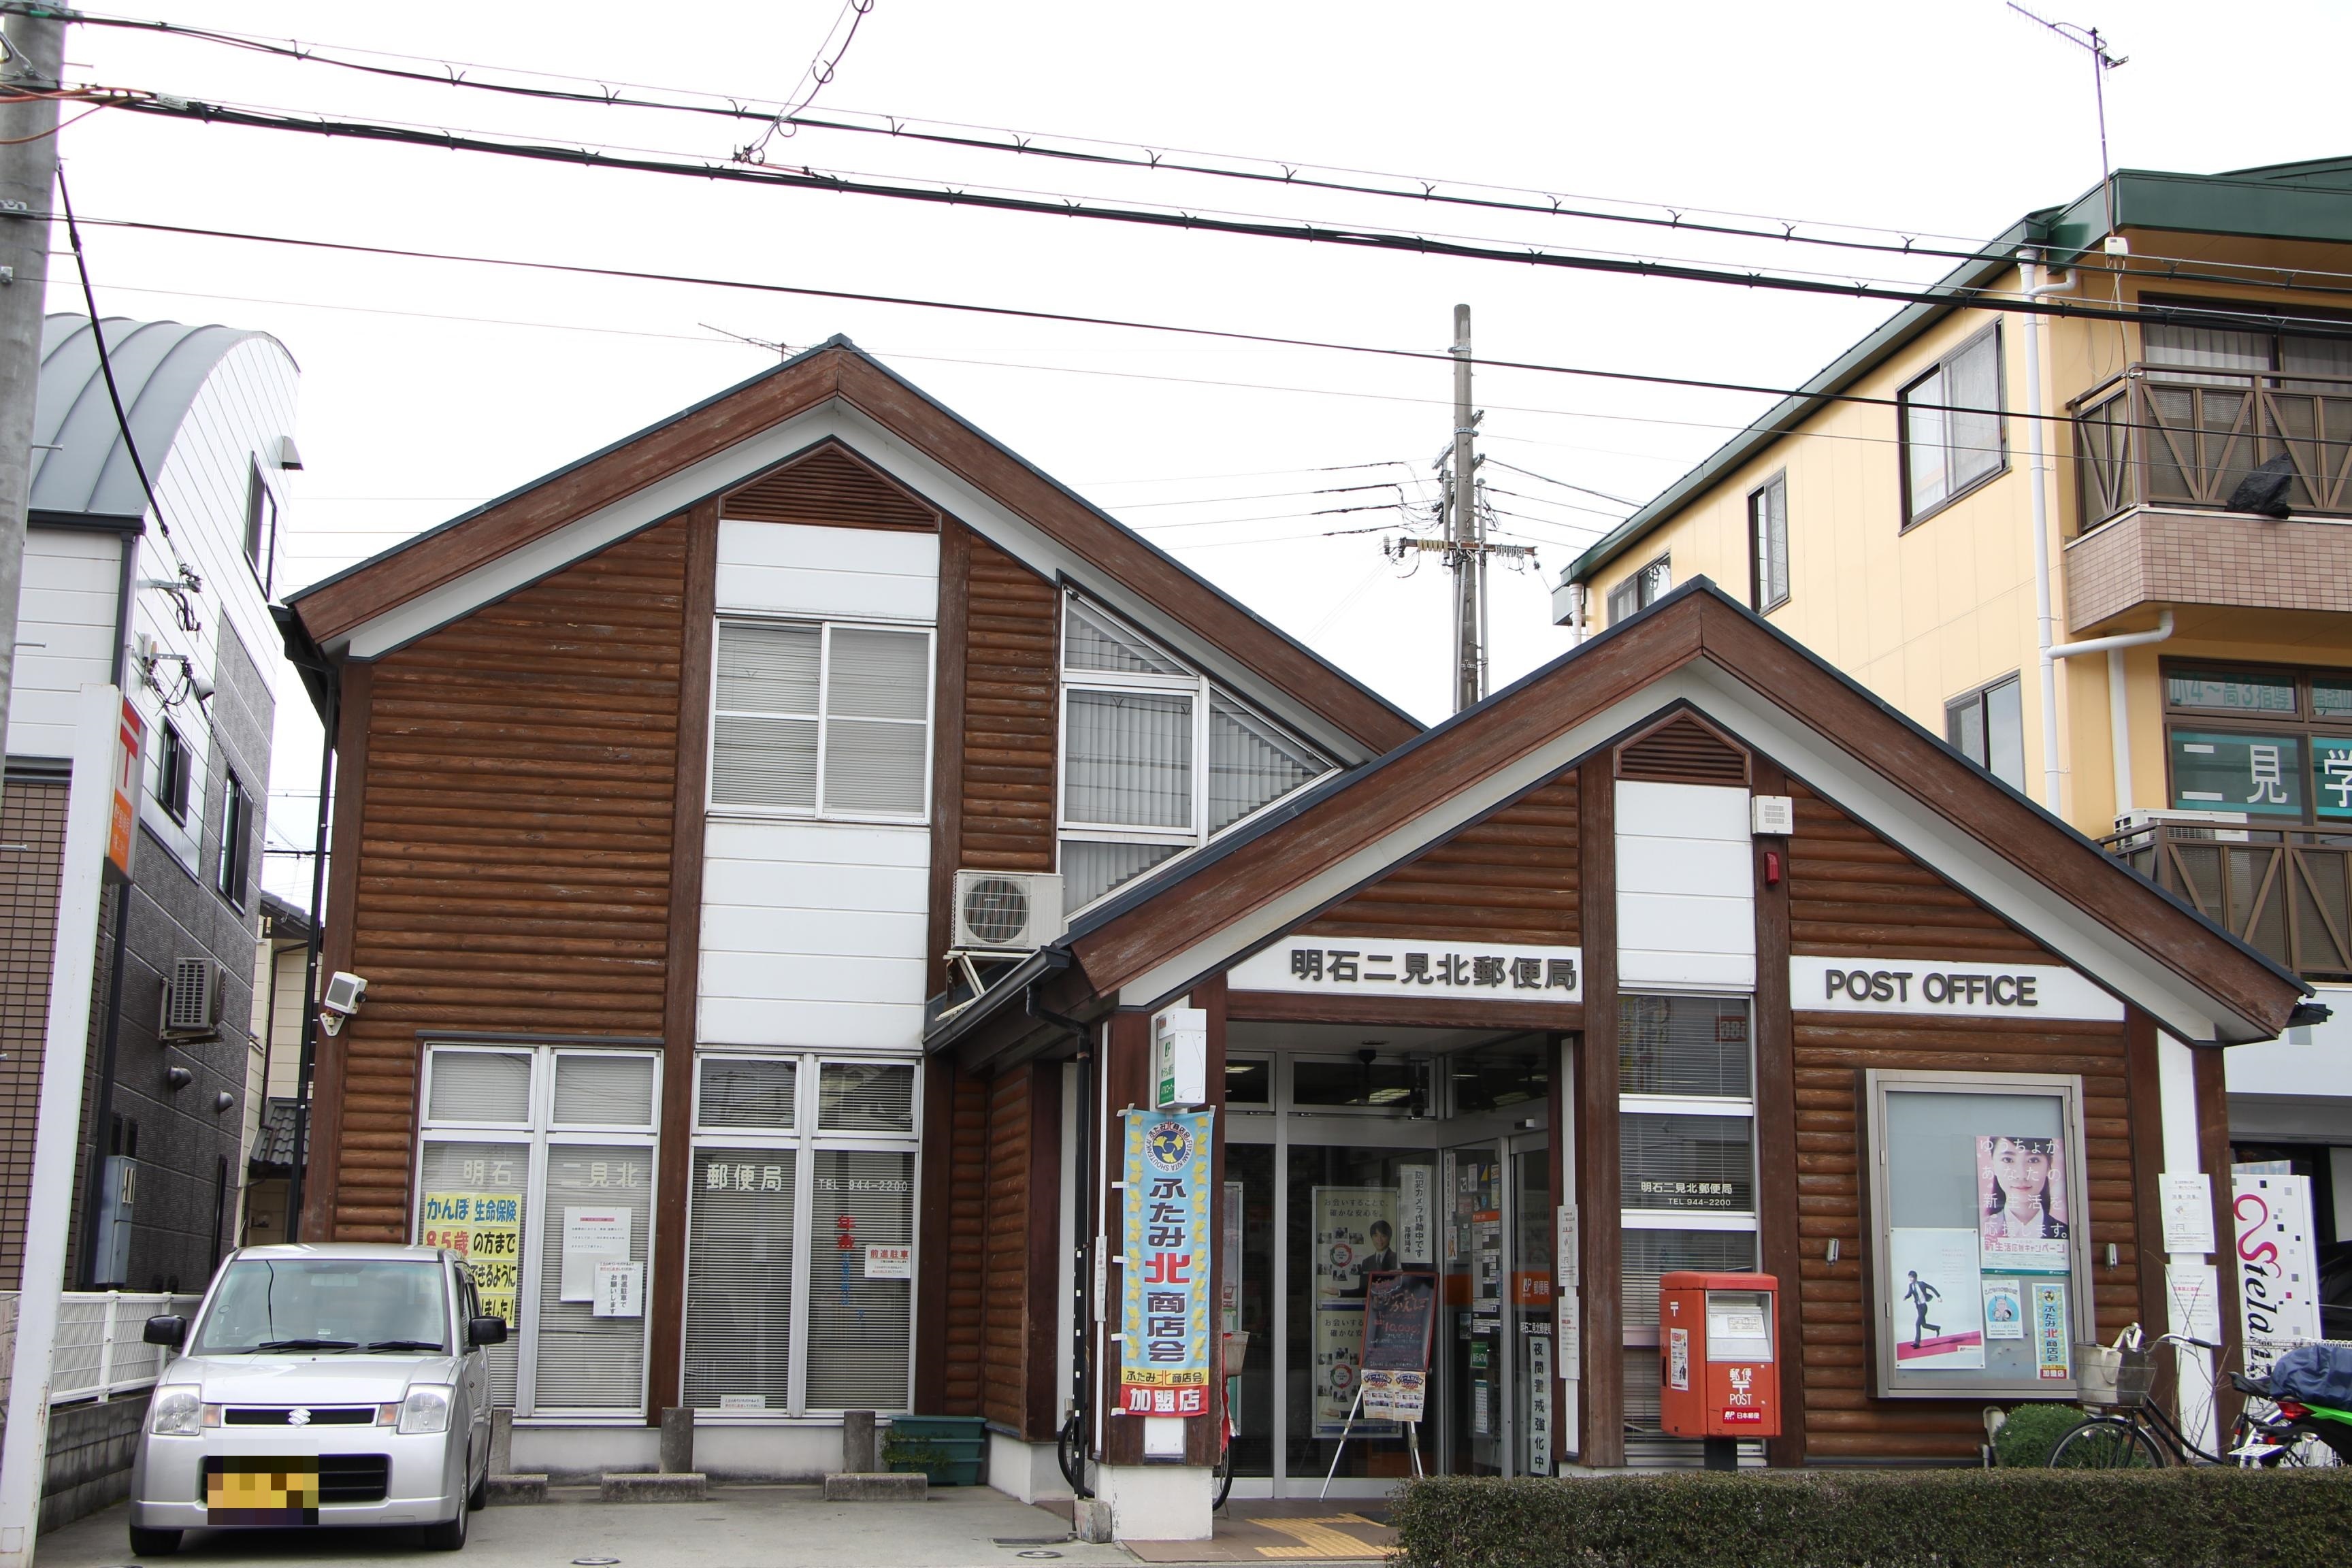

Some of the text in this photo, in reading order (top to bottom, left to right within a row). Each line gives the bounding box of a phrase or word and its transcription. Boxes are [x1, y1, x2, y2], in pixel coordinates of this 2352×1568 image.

[1291, 949, 1578, 990] 明石二見北郵便局
[1826, 969, 2038, 1006] POST OFFICE
[463, 1160, 782, 1191] 明石 二見北 郵便局
[1982, 1165, 2061, 1181] あなたの
[819, 1179, 908, 1191] TEL 944-2200
[1641, 1181, 1733, 1194] 明石二見北郵便局
[1687, 1198, 1731, 1206] 944-2200
[1983, 1193, 2062, 1209] 新生活を
[1415, 1171, 1424, 1258] 防犯カメラ作動中です
[1145, 1178, 1191, 1362] ふたみ北商店会
[1126, 1370, 1204, 1385] ふたみ北商店会
[1729, 1368, 1752, 1382] 郵便
[1130, 1389, 1200, 1411] 加盟店
[1533, 1342, 1546, 1469] 夜間警戒強化中
[1729, 1394, 1752, 1405] POST
